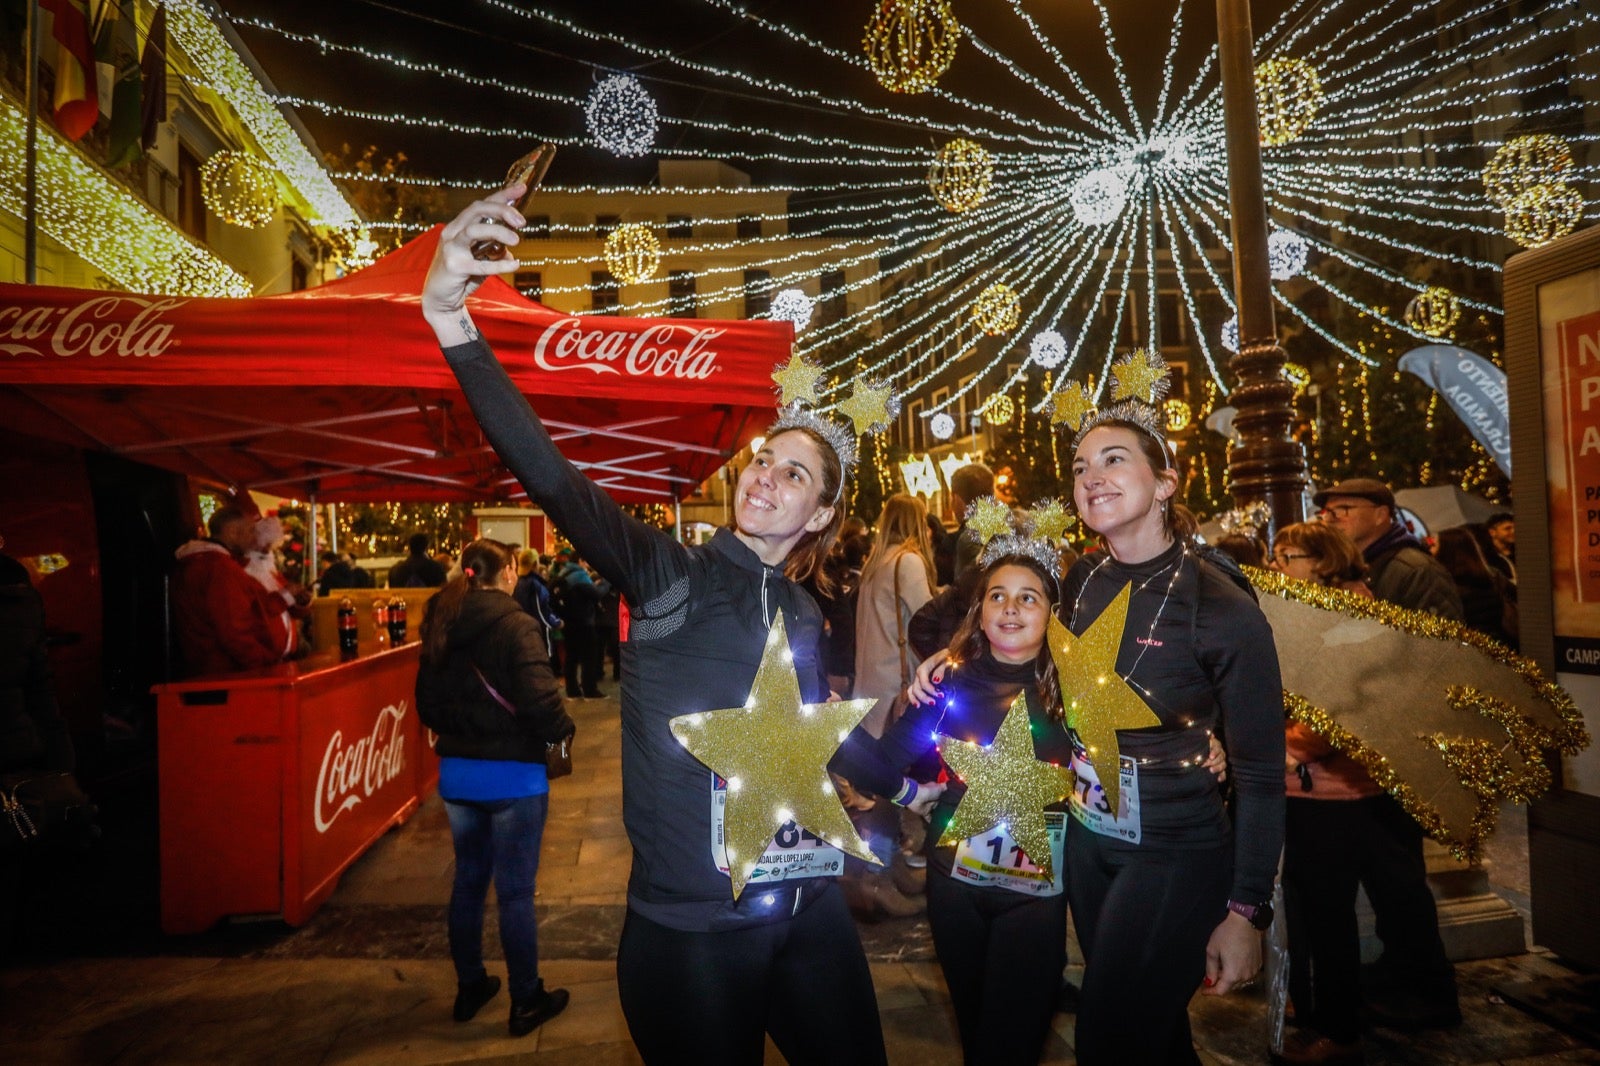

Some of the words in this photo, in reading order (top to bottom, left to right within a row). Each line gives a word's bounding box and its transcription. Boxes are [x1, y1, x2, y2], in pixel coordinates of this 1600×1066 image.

[0, 296, 191, 357] ca-Cola
[534, 318, 728, 380] Coca-Cola
[1581, 376, 1600, 411] P
[1566, 648, 1600, 664] CAMP
[314, 700, 407, 833] Coca-Cola
[759, 854, 783, 865] ADALUPE
[784, 853, 800, 863] LOPEZ
